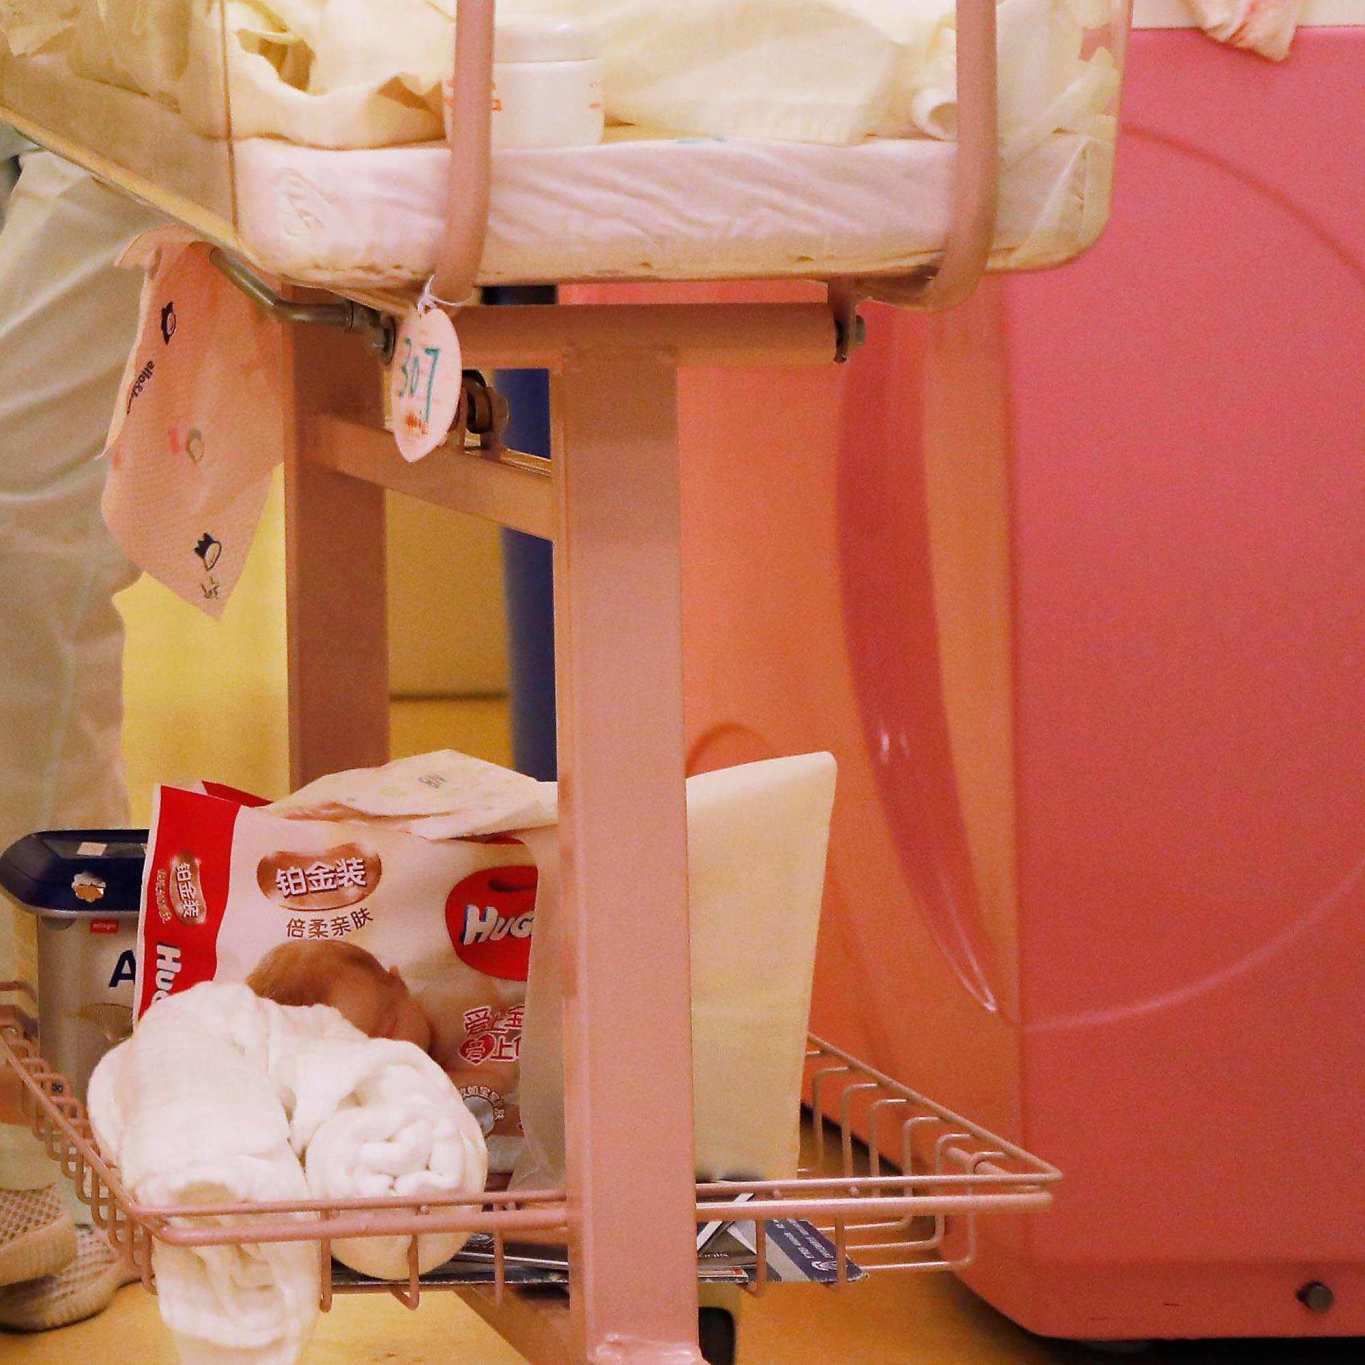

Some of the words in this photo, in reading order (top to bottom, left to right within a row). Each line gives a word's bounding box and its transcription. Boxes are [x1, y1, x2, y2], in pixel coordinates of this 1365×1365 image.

[175, 862, 200, 920] 铂金装
[274, 856, 368, 900] 铂金装
[285, 906, 374, 939] 倍柔亲肤
[107, 948, 136, 990] A
